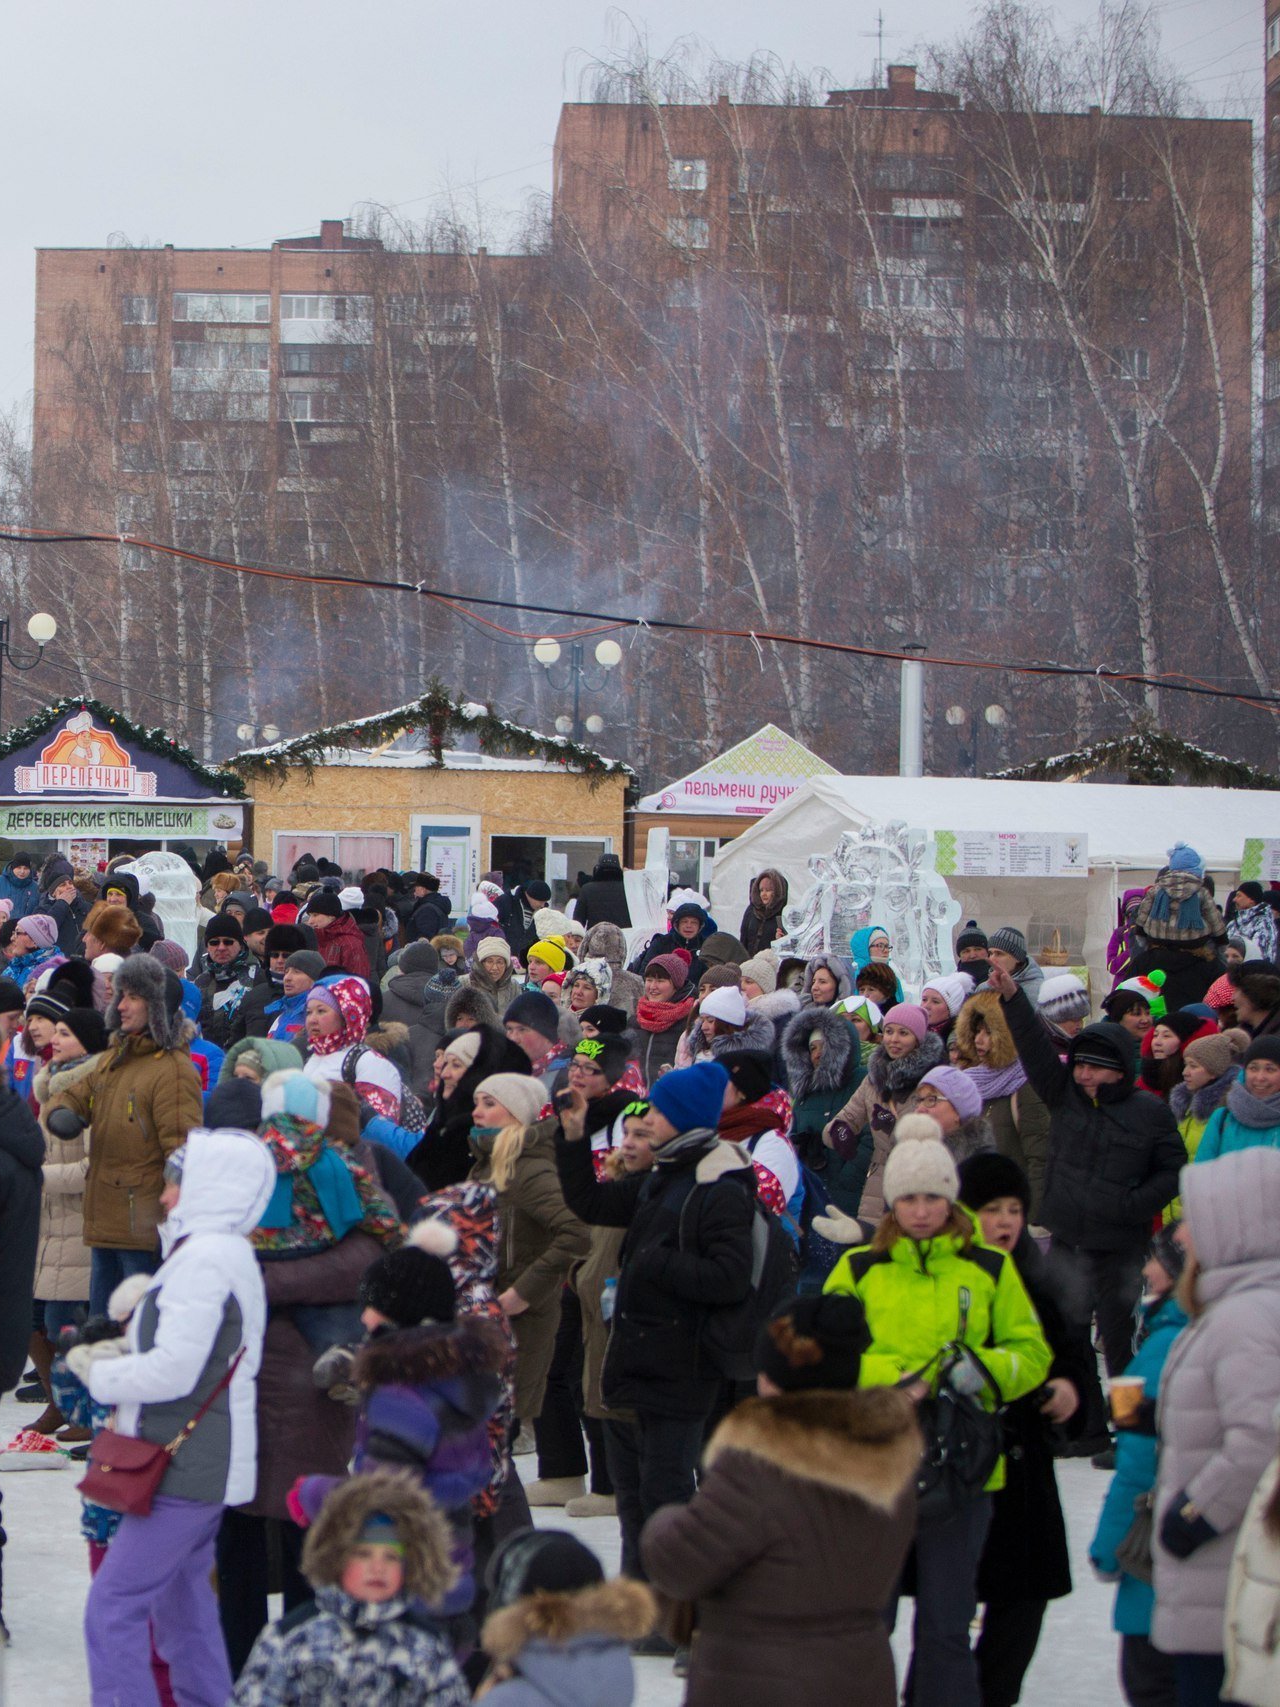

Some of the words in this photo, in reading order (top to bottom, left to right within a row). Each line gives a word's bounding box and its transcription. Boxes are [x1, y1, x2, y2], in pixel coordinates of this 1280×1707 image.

[42, 765, 130, 789] ПЕРЕПЕЧКИН
[684, 780, 756, 799] пельмени
[6, 811, 106, 831] ДЕРЕВЕНСКИЕ
[109, 811, 193, 829] ПЕЛЬМЕШКИ
